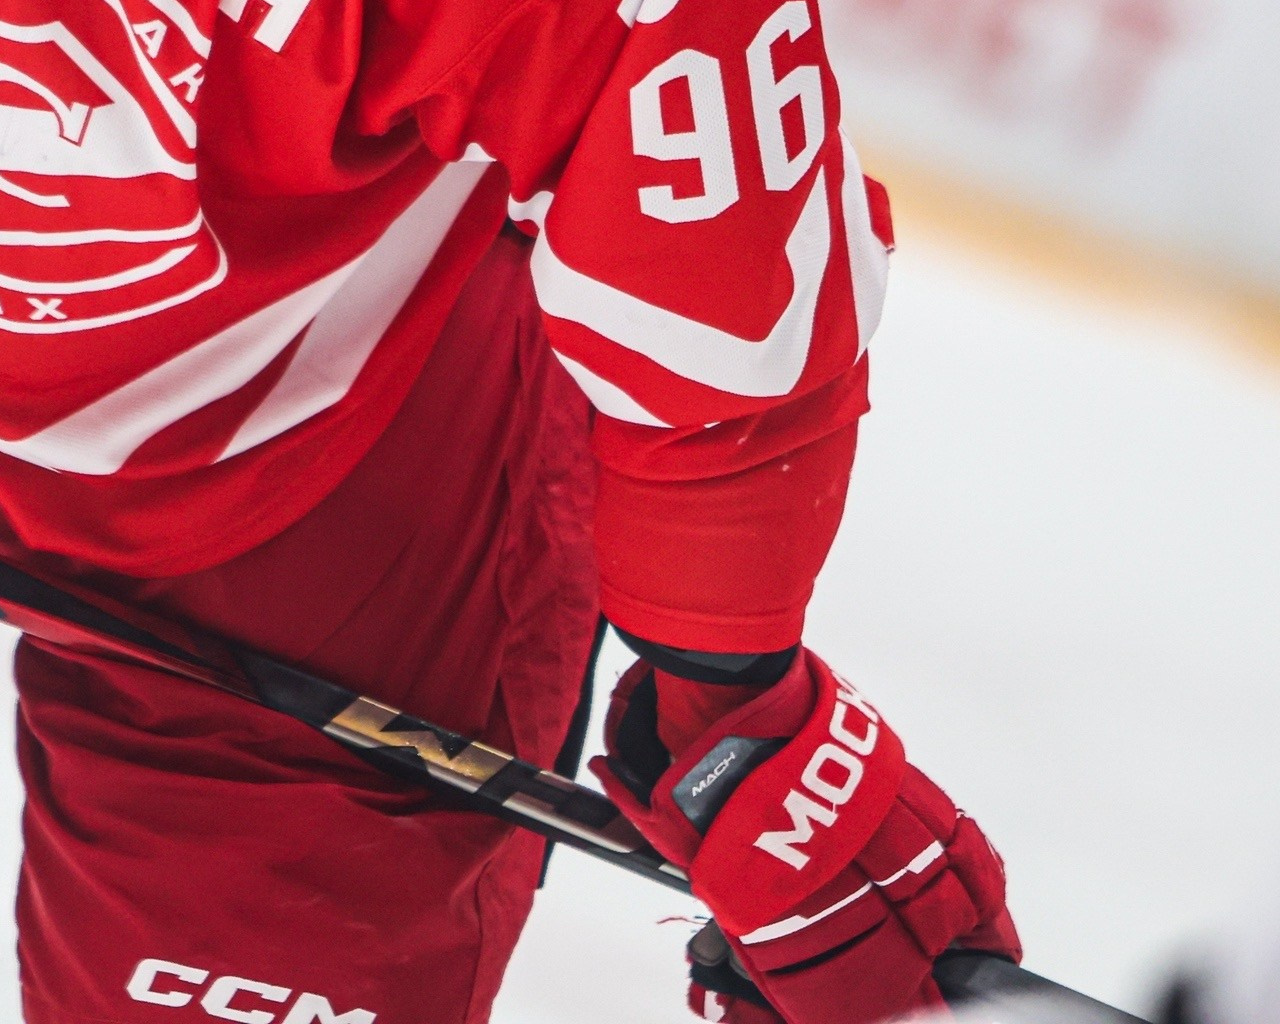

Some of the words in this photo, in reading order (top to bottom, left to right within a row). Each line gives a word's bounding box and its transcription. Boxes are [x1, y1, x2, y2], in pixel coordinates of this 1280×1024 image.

[629, 0, 826, 225] 96
[691, 751, 736, 798] MACH
[124, 957, 378, 1024] CCM
